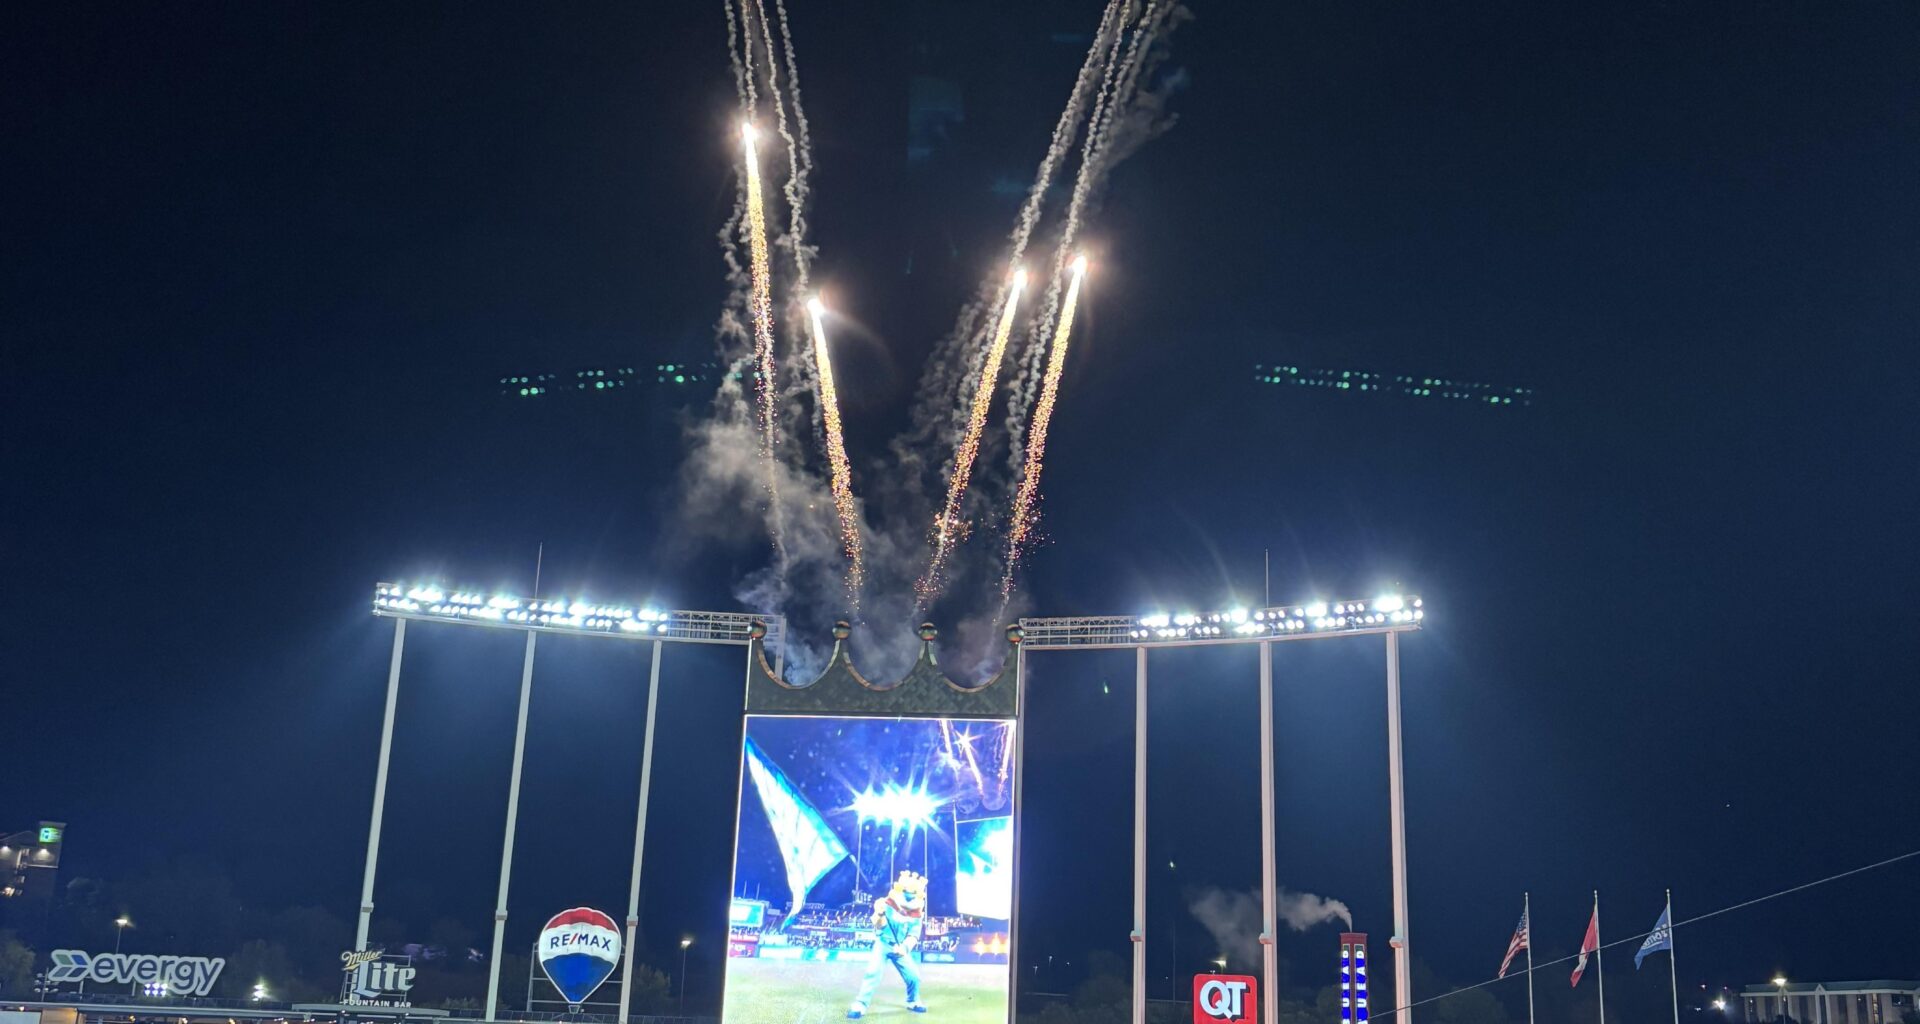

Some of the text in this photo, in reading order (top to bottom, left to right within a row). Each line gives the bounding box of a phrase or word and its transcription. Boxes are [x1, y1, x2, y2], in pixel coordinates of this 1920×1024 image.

[550, 932, 612, 951] RE/MAX
[93, 955, 221, 994] evergy
[341, 949, 385, 971] Miller
[353, 961, 416, 998] Lite
[343, 999, 390, 1007] FOUNTAIN
[1200, 980, 1247, 1019] QT
